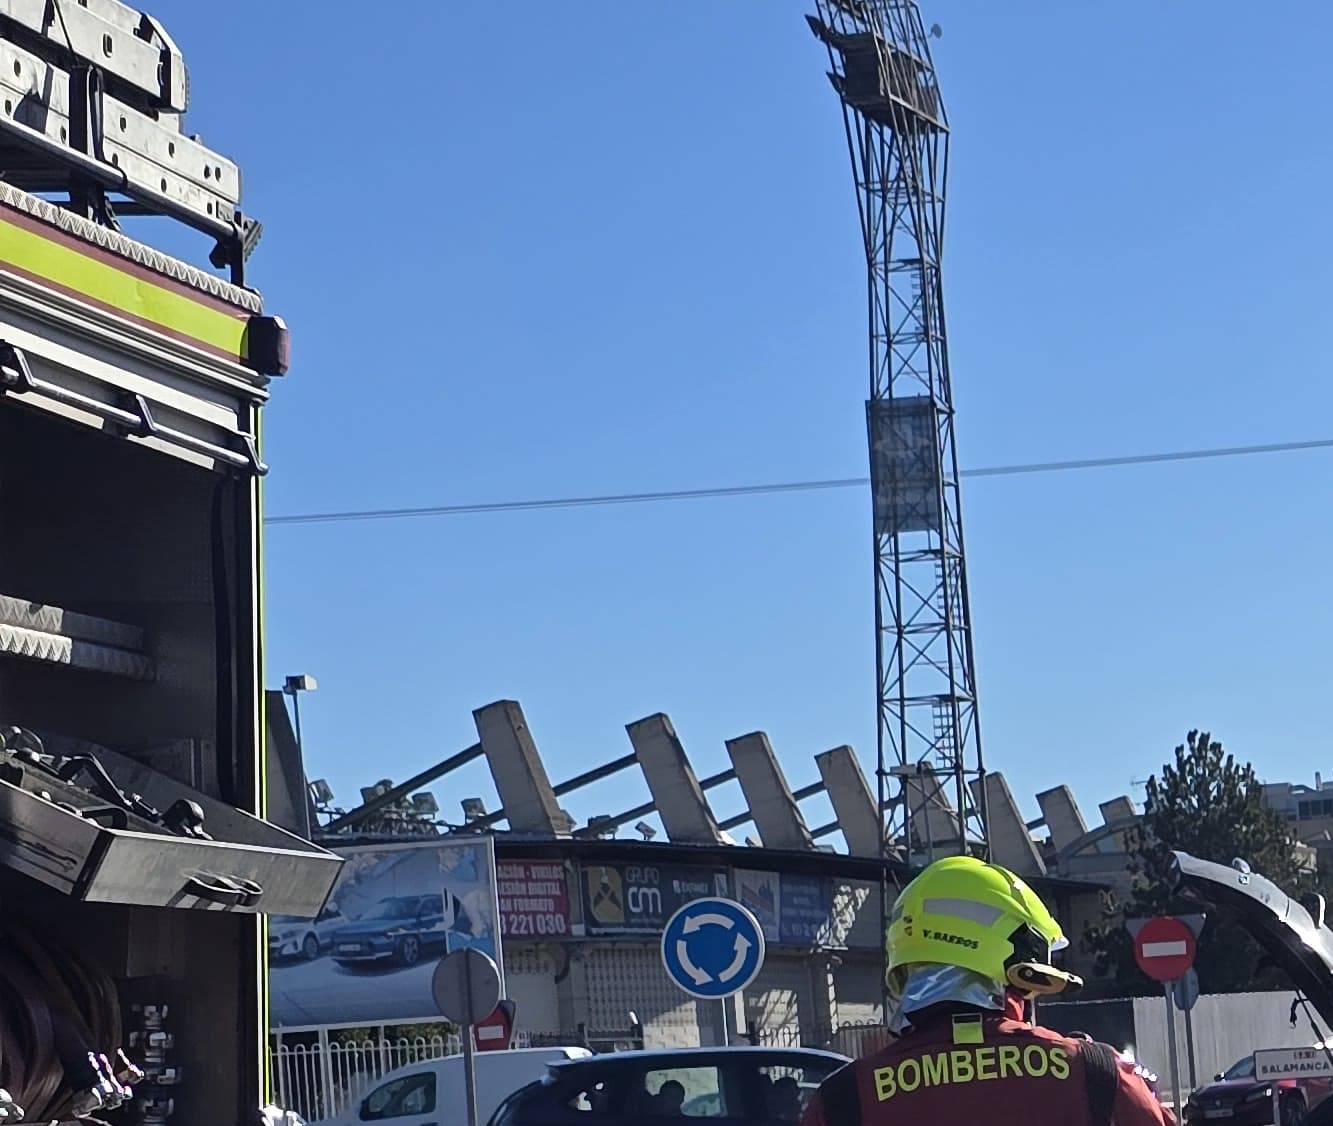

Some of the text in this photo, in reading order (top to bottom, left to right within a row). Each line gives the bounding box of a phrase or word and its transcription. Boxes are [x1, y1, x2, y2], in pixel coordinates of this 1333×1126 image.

[510, 914, 535, 935] 221
[536, 913, 566, 934] 030
[873, 1044, 1070, 1103] BOMBEROS
[1261, 1061, 1330, 1075] SALAMANCA
